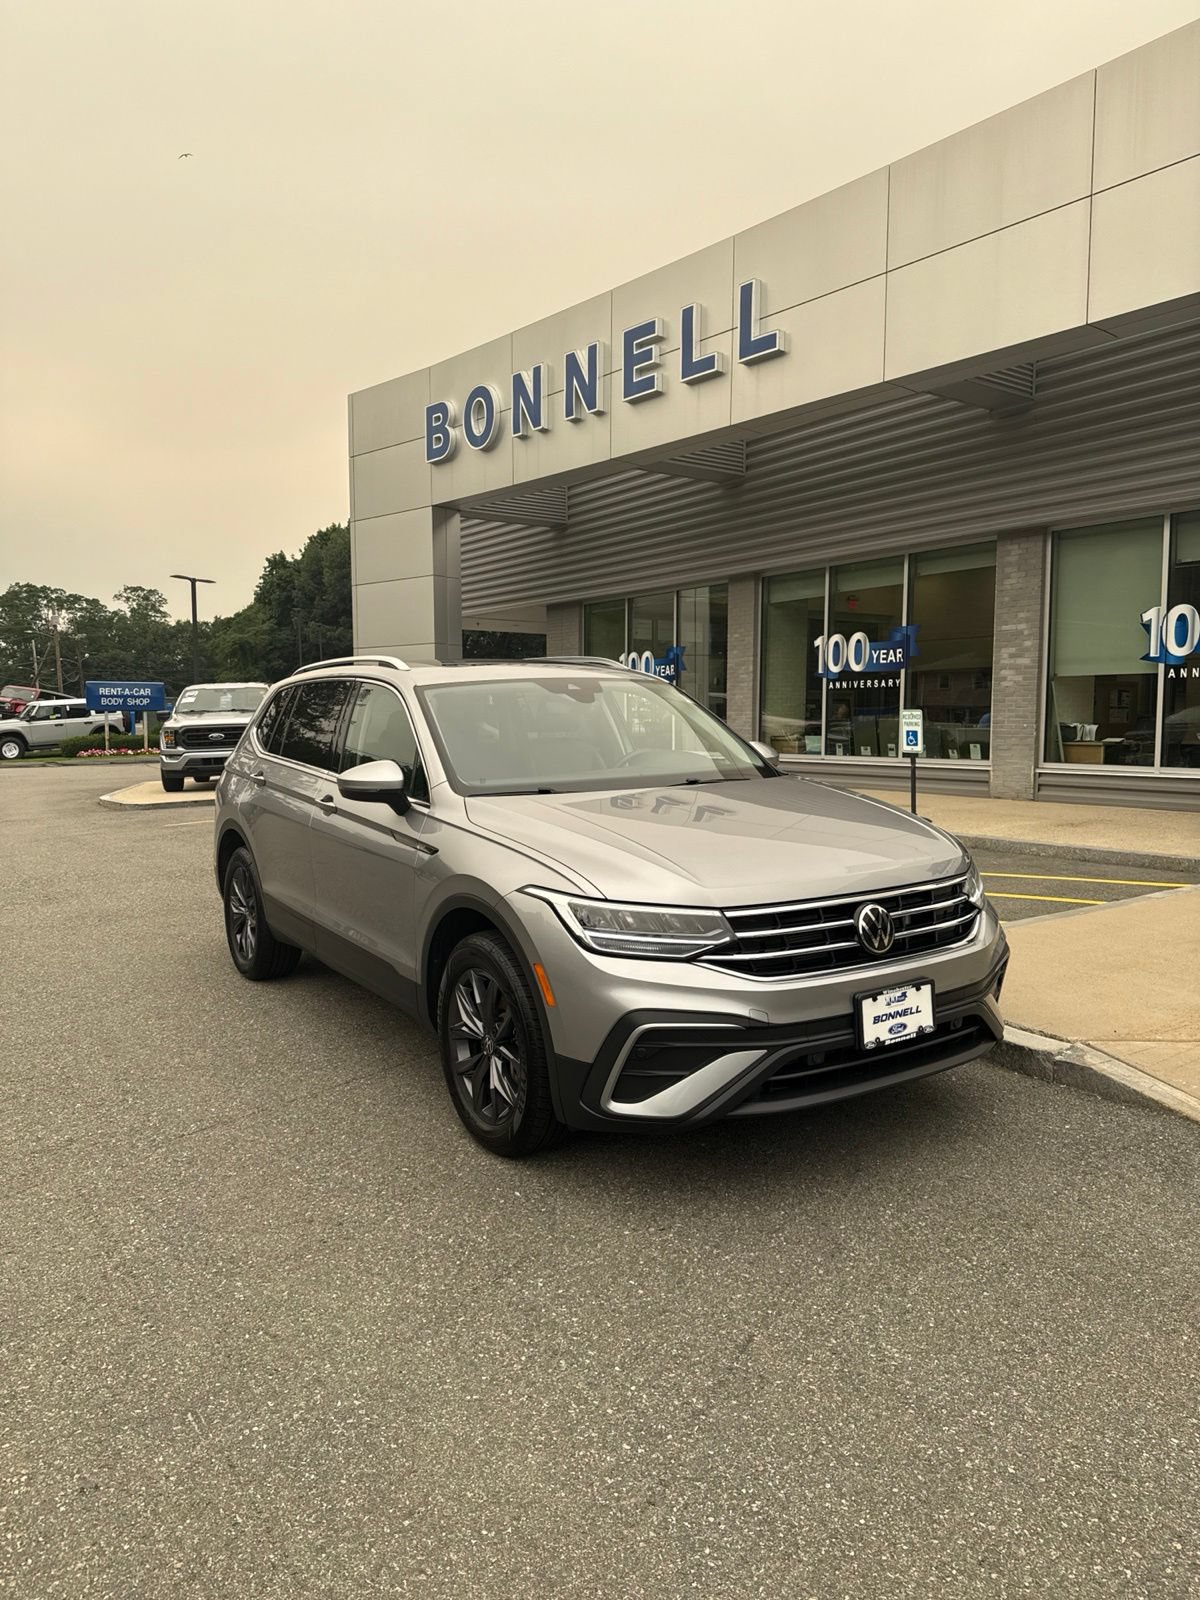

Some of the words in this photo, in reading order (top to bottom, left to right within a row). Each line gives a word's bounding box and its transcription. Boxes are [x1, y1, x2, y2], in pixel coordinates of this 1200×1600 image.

[425, 278, 786, 464] BONNELL
[813, 631, 870, 674] 100
[872, 648, 904, 664] YEAR
[655, 664, 675, 677] YEAR
[828, 679, 901, 690] ANNIVERSARY
[99, 687, 151, 696] RENT-A-CAR
[101, 697, 124, 706] BODY
[127, 697, 150, 706] SHOP
[872, 1005, 922, 1025] BONNELL
[884, 1032, 917, 1046] Bonnell
